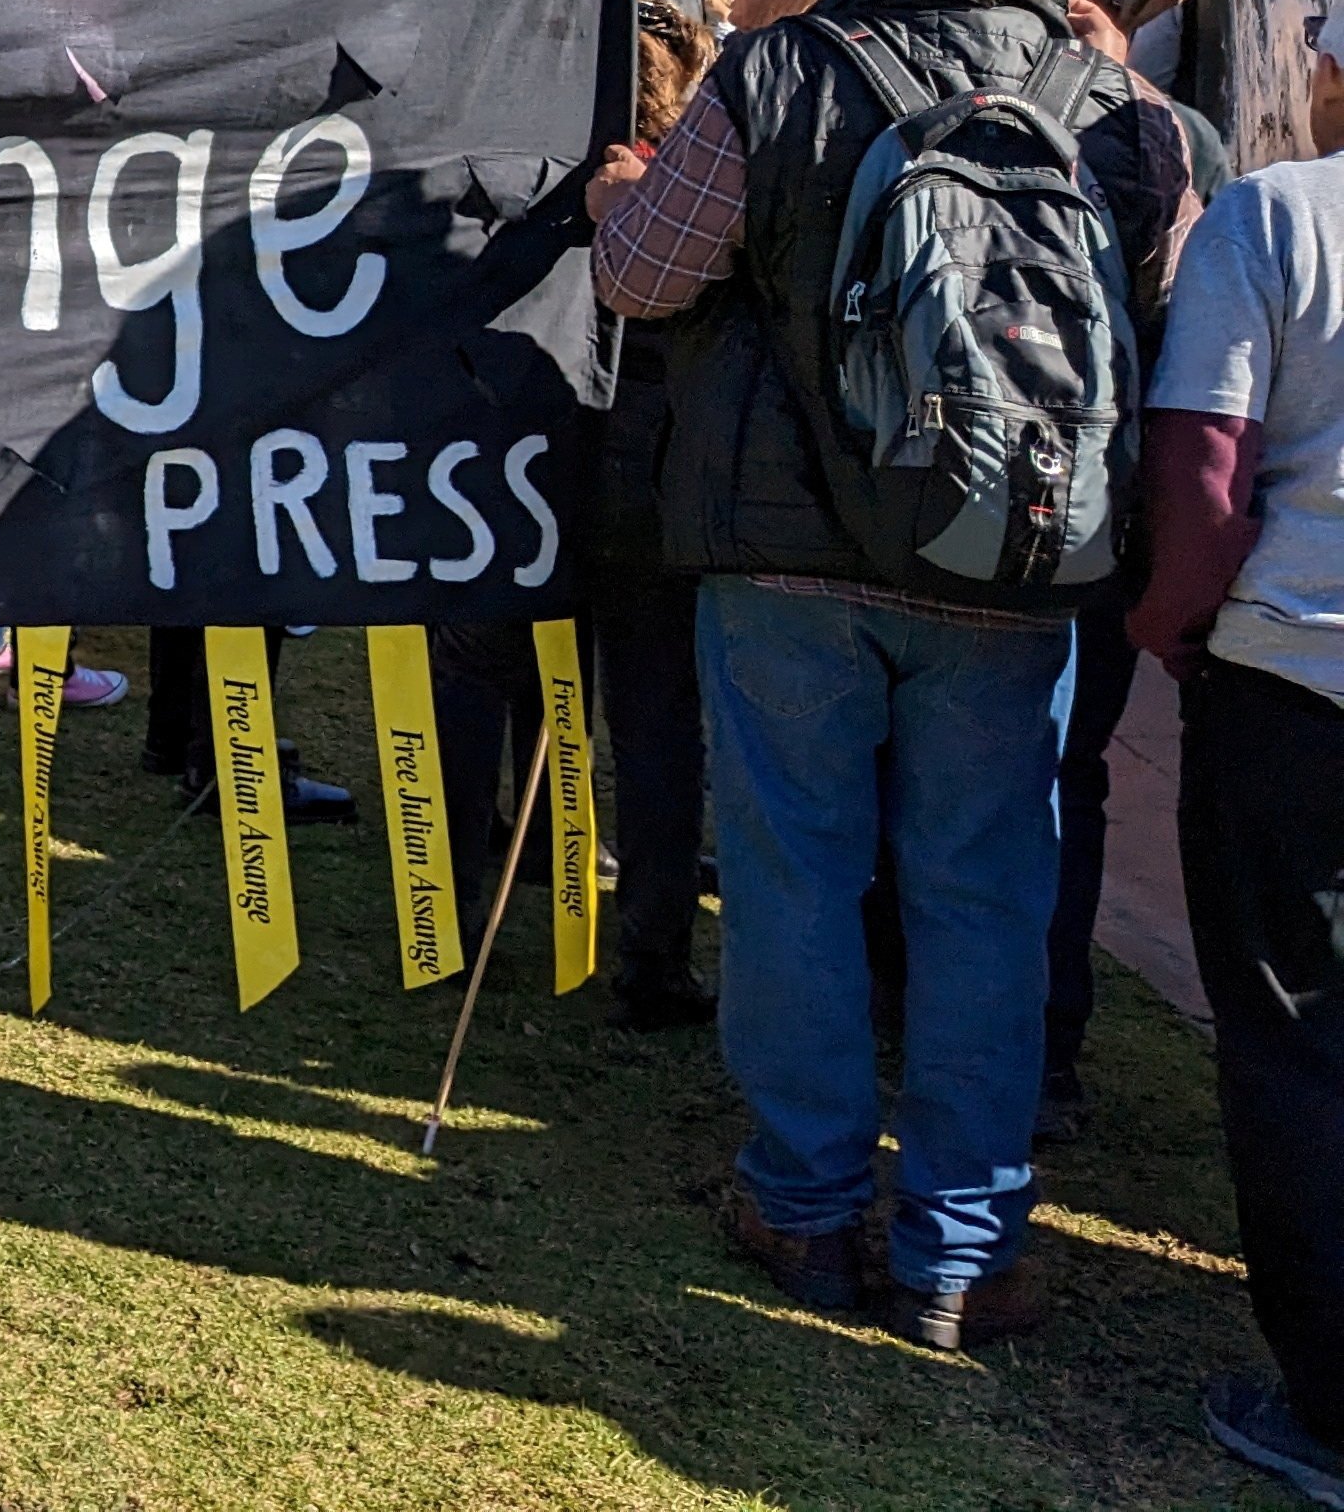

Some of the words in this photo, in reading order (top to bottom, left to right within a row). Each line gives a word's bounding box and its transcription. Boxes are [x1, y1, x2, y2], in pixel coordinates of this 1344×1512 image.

[143, 427, 559, 589] PRESS
[33, 663, 64, 721] Free
[224, 679, 258, 732] Free
[552, 678, 575, 730] Free
[230, 737, 263, 814] Julian
[391, 728, 424, 782] Free
[558, 735, 581, 810] Julian
[398, 788, 433, 865] Julian
[237, 820, 272, 923] Assange
[560, 818, 587, 918] Assange
[408, 872, 442, 975] Assange
